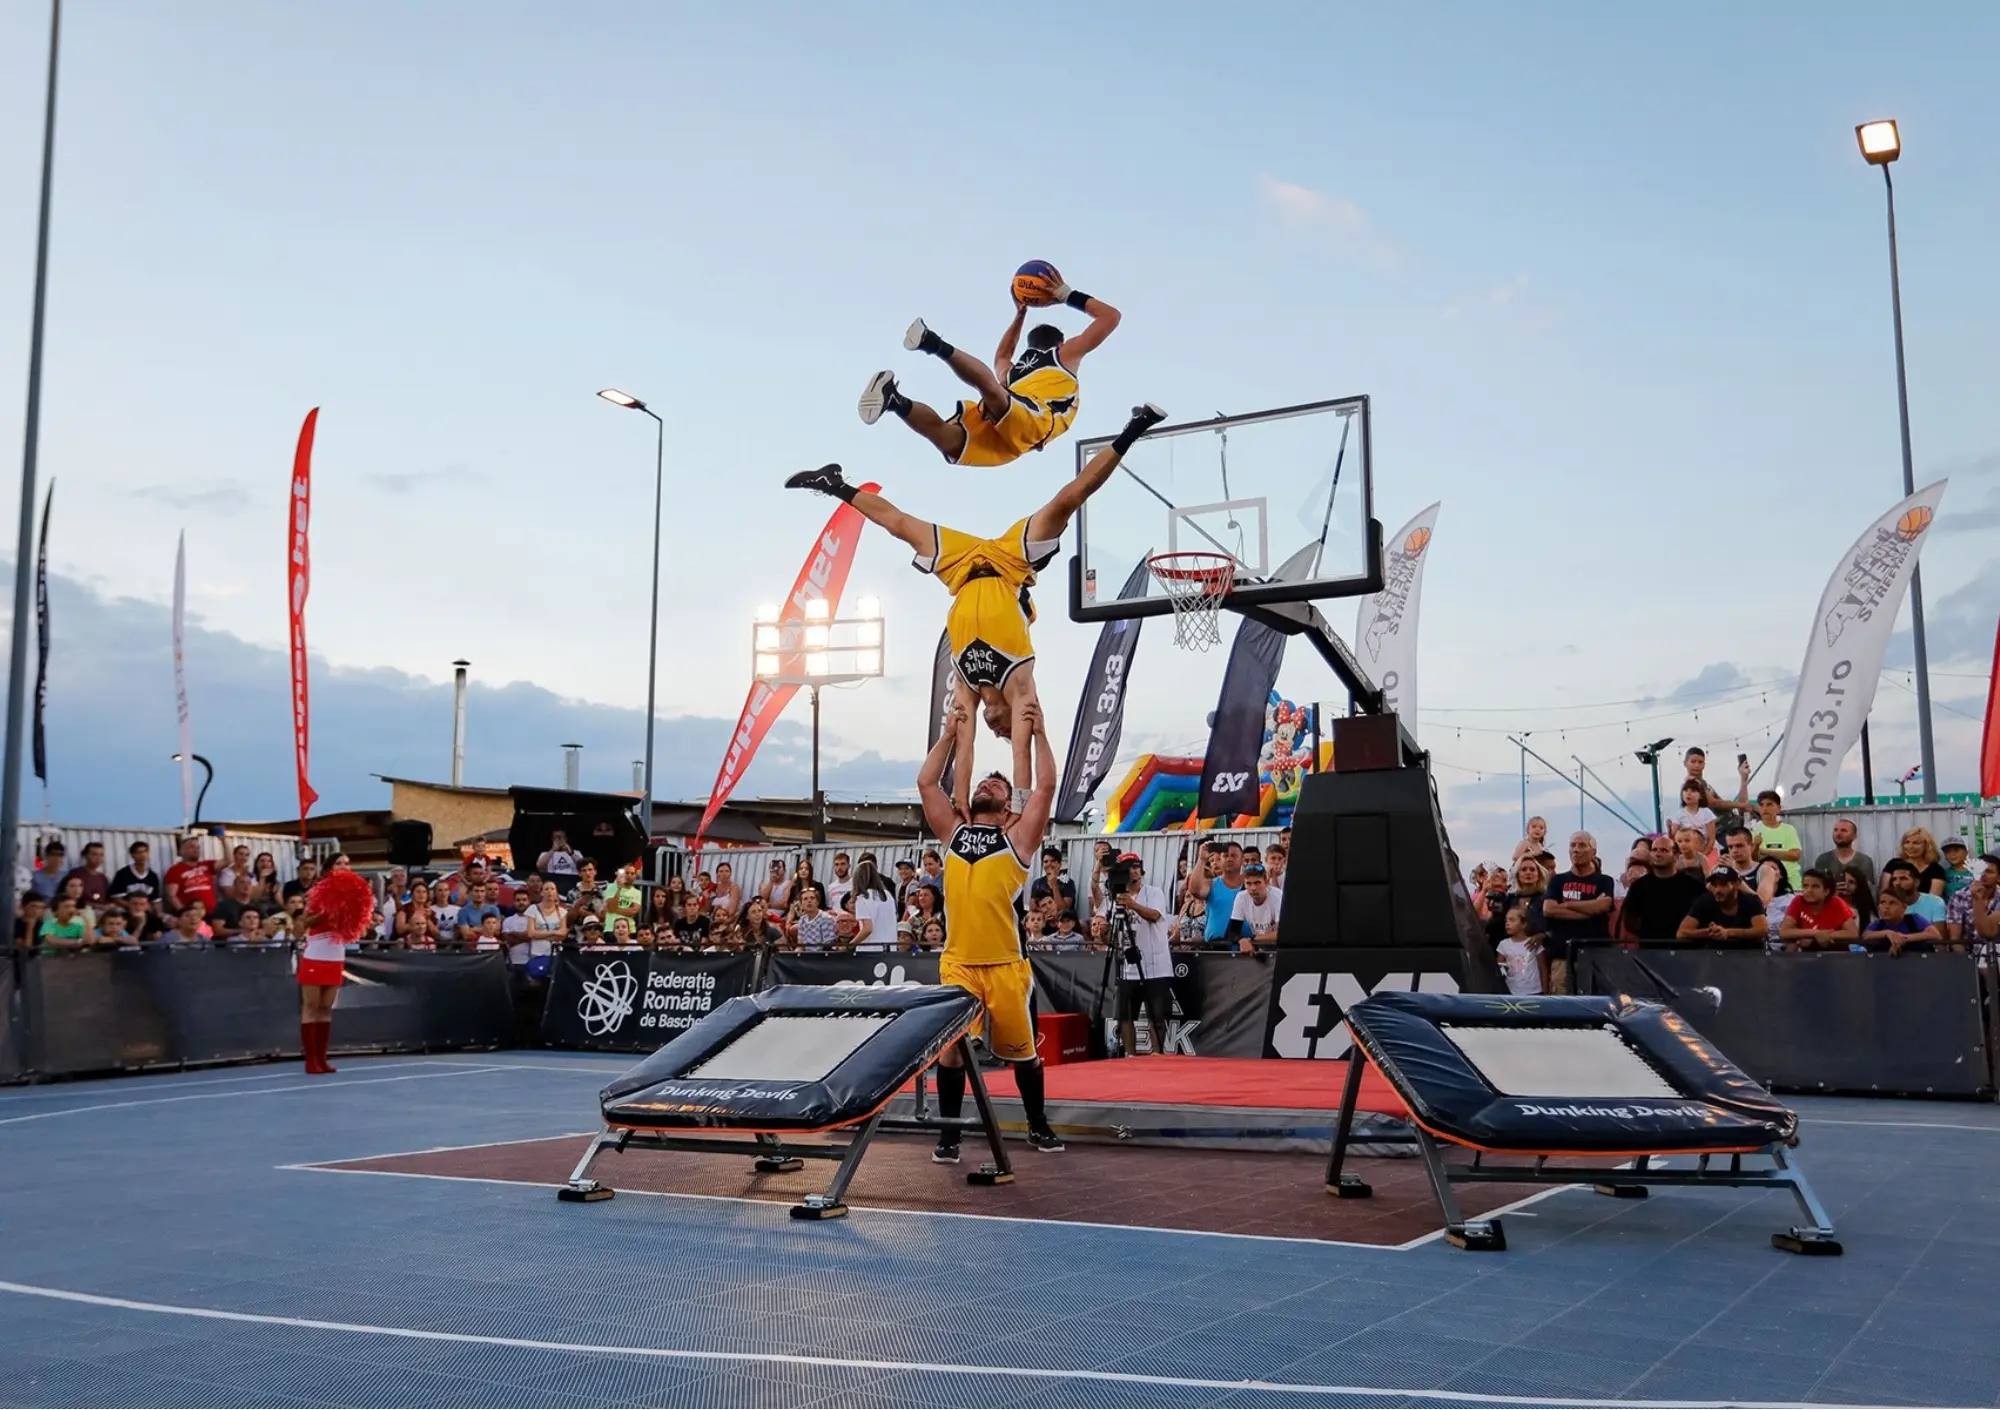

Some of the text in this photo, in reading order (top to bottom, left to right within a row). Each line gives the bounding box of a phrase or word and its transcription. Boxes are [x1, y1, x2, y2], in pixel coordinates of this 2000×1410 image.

[1077, 721, 1111, 793] FIBA
[647, 971, 716, 993] Federația
[642, 990, 712, 1011] Română
[640, 1012, 704, 1028] de Basche
[656, 1086, 798, 1101] Dunking Devils
[1514, 1104, 1634, 1119] Dunking
